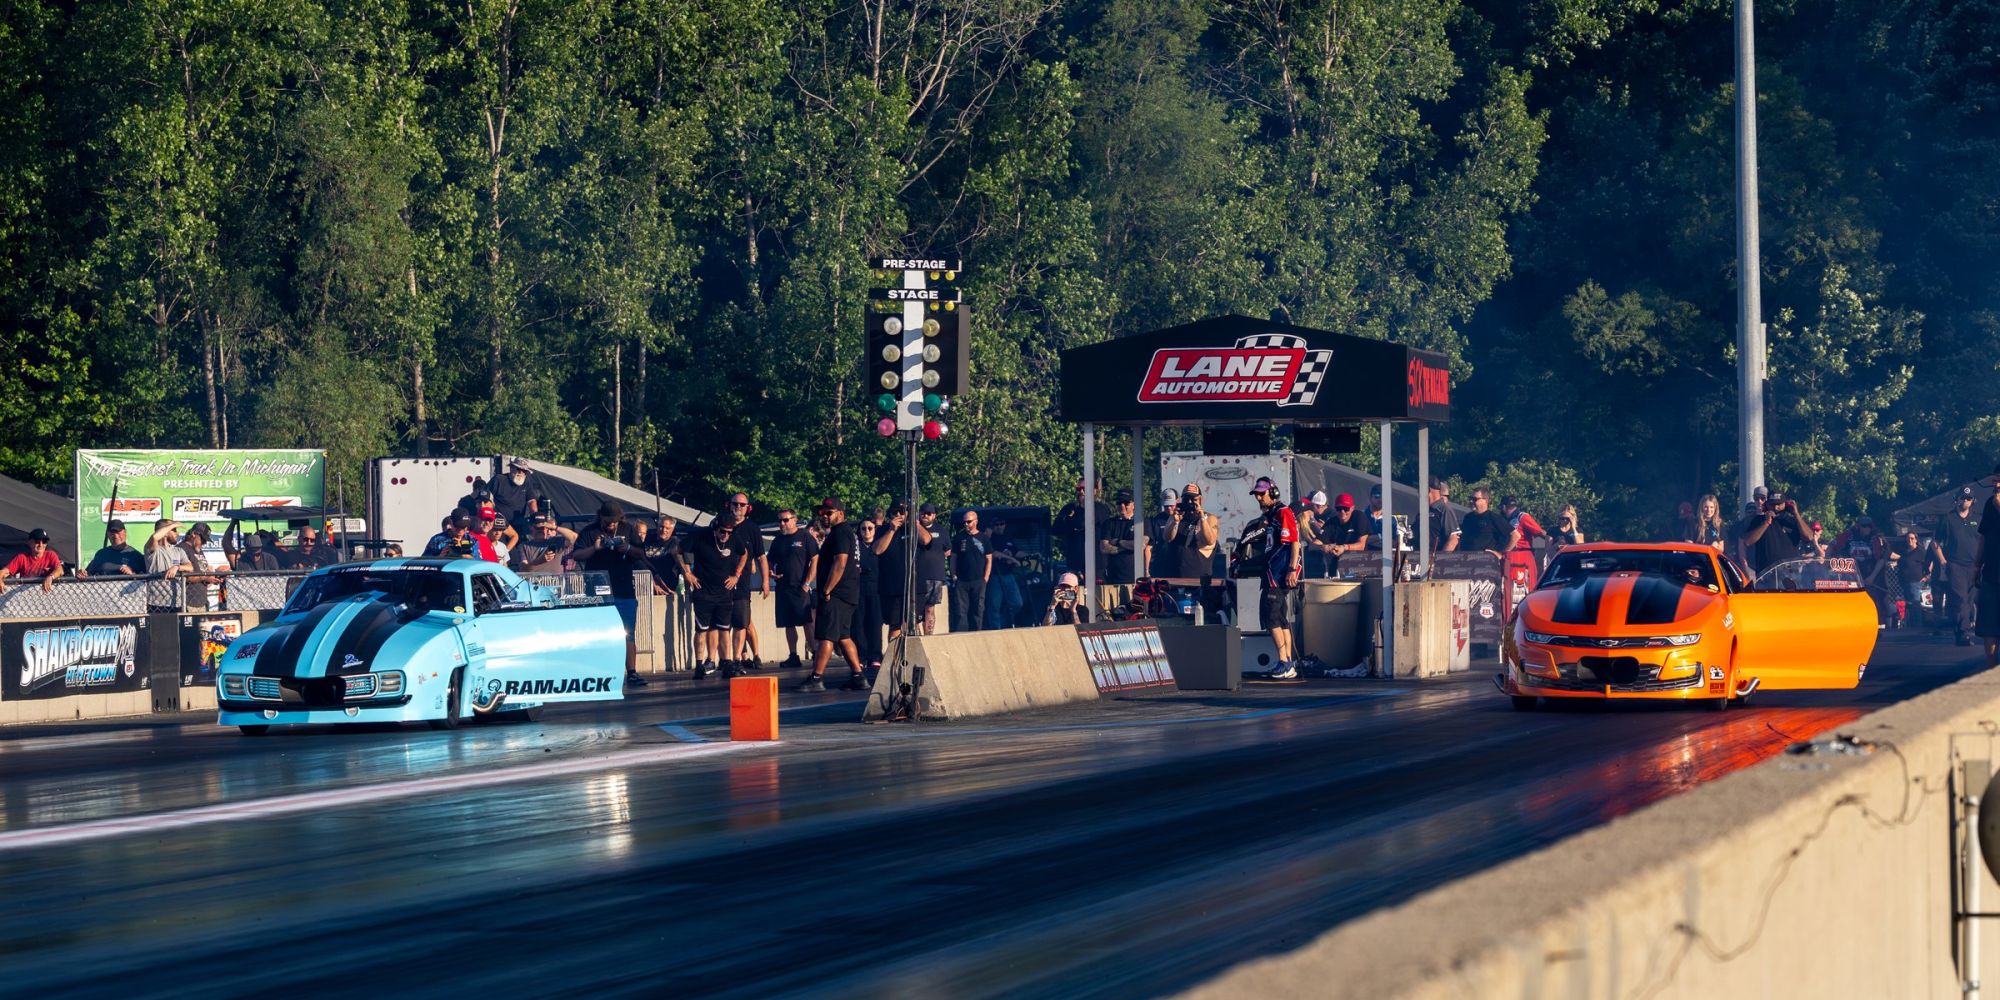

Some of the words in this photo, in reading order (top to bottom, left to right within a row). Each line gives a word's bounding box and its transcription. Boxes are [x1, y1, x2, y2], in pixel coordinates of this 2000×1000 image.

[883, 259, 946, 268] PRE-STAGE
[888, 290, 938, 299] STAGE
[1160, 354, 1290, 378] LANE
[1151, 380, 1284, 394] AUTOMOTIVE
[177, 459, 217, 477] Track
[217, 460, 236, 477] In
[238, 458, 316, 480] Michigan!
[164, 480, 222, 489] PRESENTED
[225, 480, 239, 488] BY
[104, 499, 160, 512] ARP
[21, 624, 120, 687] SHAKEDOWN
[505, 677, 612, 694] RAMJACK
